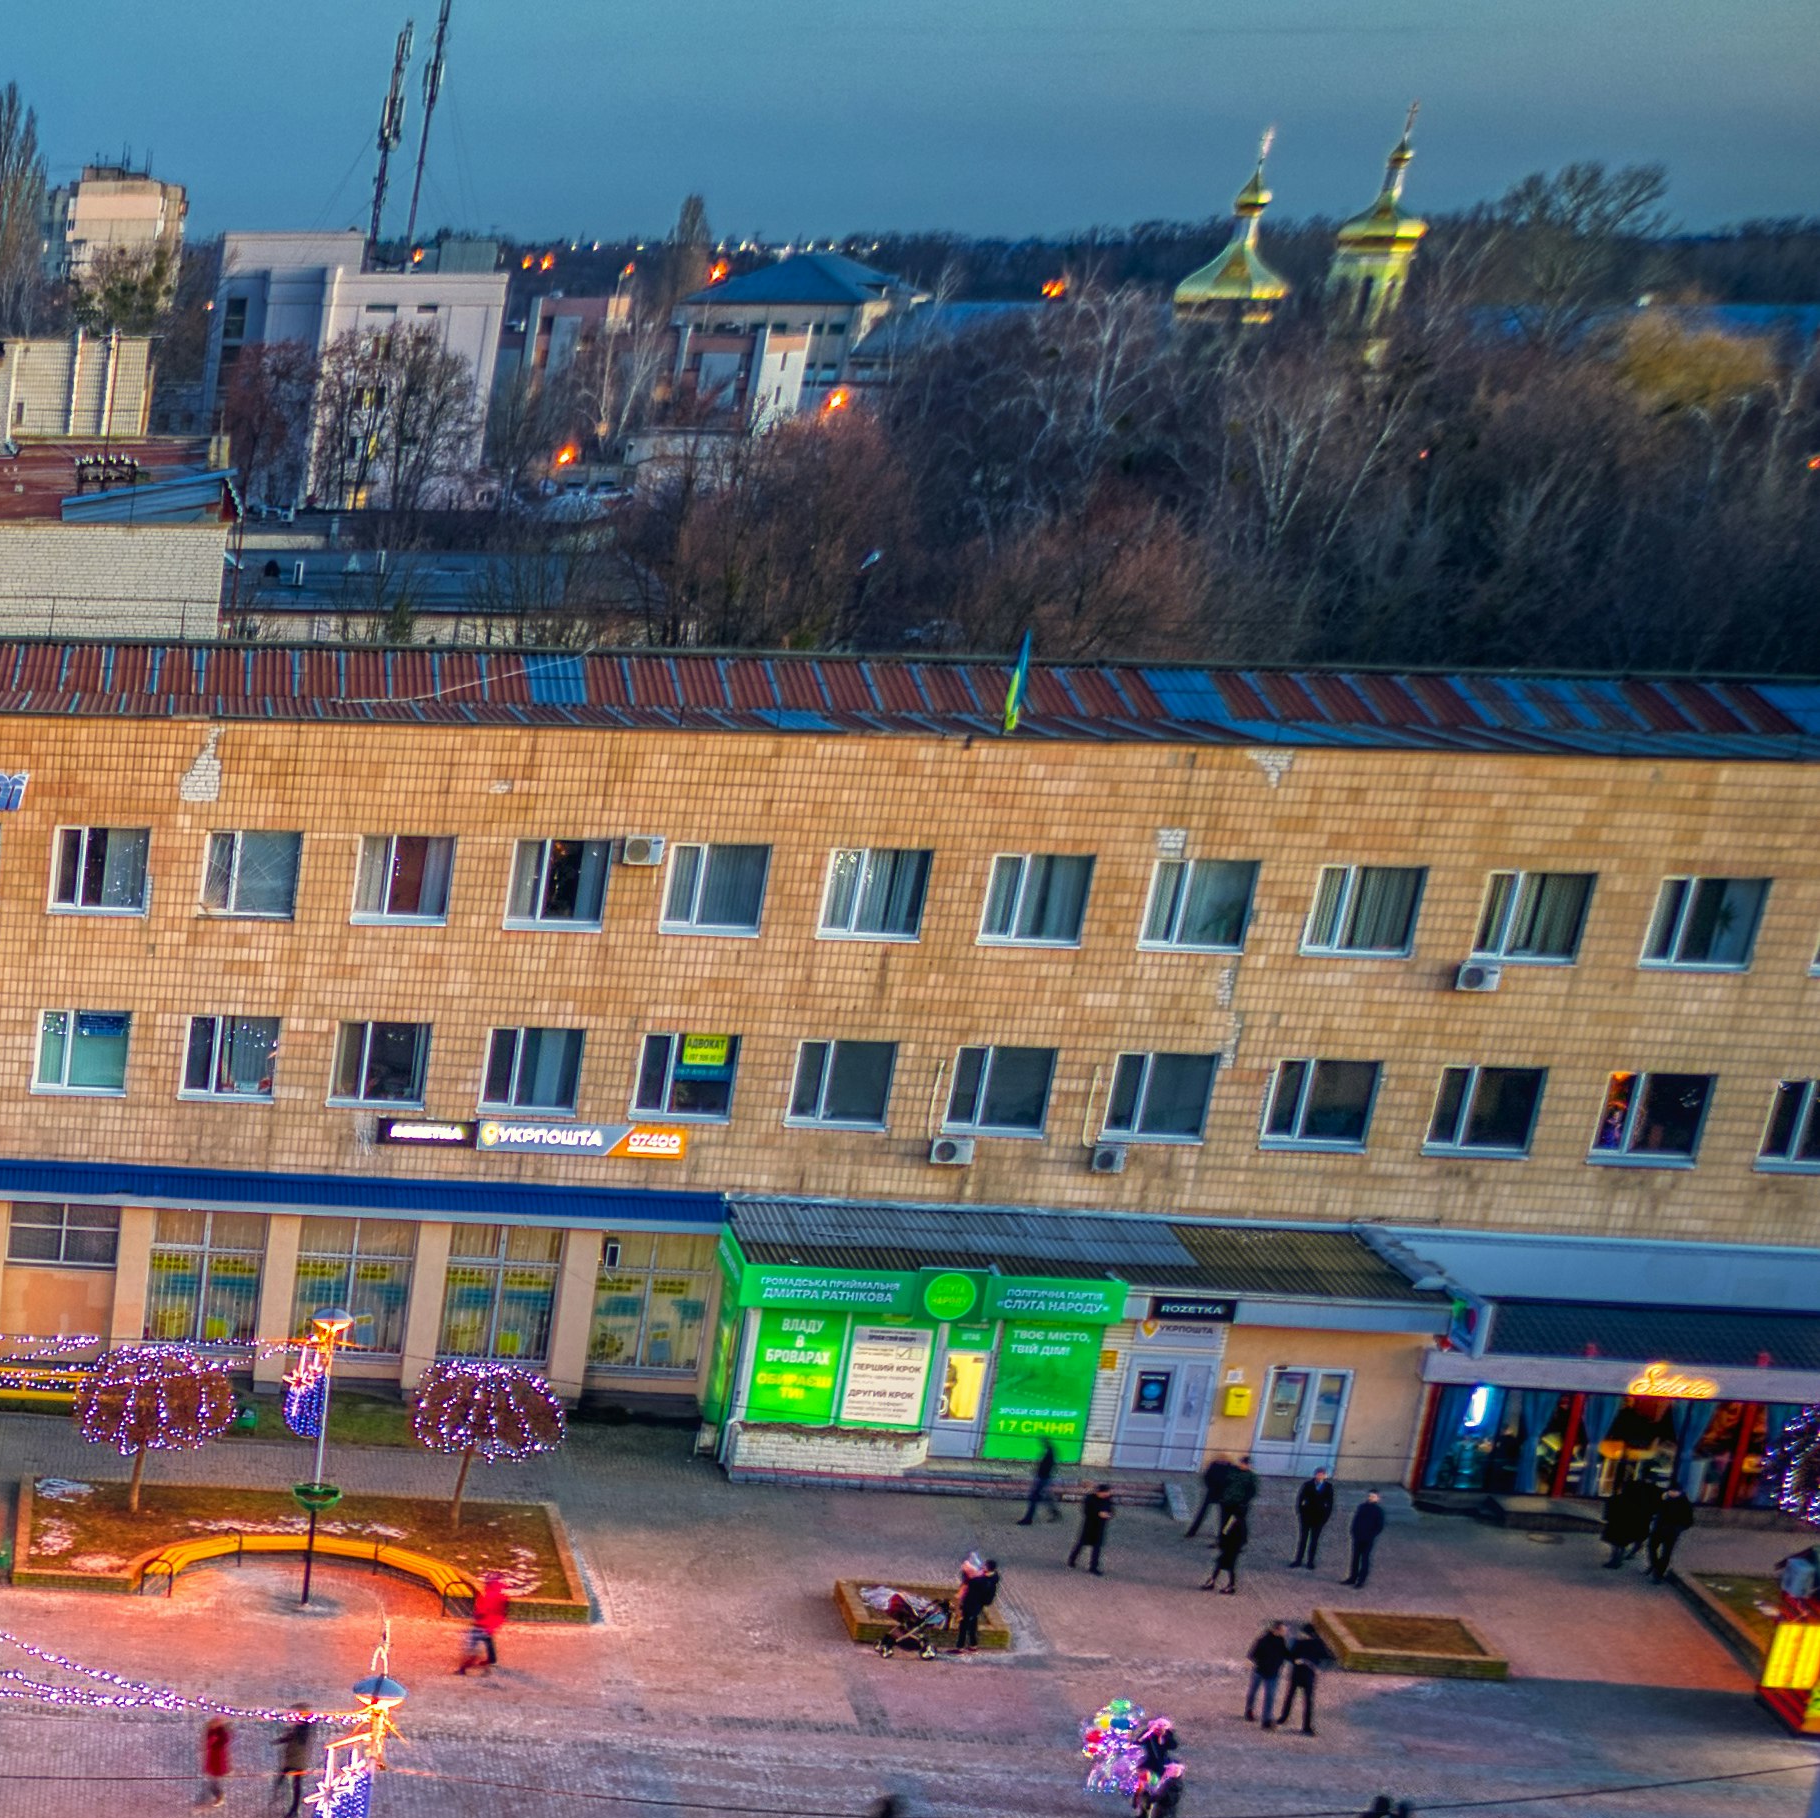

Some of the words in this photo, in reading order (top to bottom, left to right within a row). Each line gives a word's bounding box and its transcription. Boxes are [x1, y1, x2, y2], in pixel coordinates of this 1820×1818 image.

[687, 1037, 725, 1049] АДВОКАТ
[498, 1127, 602, 1147] УКРПОШТА
[629, 1133, 681, 1147] 07400
[761, 1276, 827, 1288] ГРОМАДСЬКА
[830, 1279, 900, 1292] ПРИЙМАЛЬНЯ
[763, 1286, 819, 1300] ДМИТРА
[822, 1290, 893, 1304] РАТНІКОВА
[1007, 1288, 1066, 1300] ПОЛІТИЧНА
[1068, 1290, 1104, 1301] ПАРТІЯ
[1161, 1304, 1223, 1315] ROZETKA
[782, 1318, 824, 1334] ВЛАДУ
[1161, 1324, 1213, 1335] УКРПОШТА
[795, 1336, 804, 1348] В
[1013, 1329, 1045, 1341] ТВОЄ
[1047, 1331, 1091, 1344] МІСТО,
[1010, 1343, 1038, 1354] ТВІЙ
[765, 1348, 831, 1365] БРОВАРАХ
[853, 1362, 894, 1372] ПЕРШИЙ
[896, 1365, 922, 1374] КРОК
[848, 1388, 887, 1398] ДРУГИЙ
[888, 1391, 915, 1400] КРОК
[1021, 1420, 1076, 1435] СІЧНЯ
